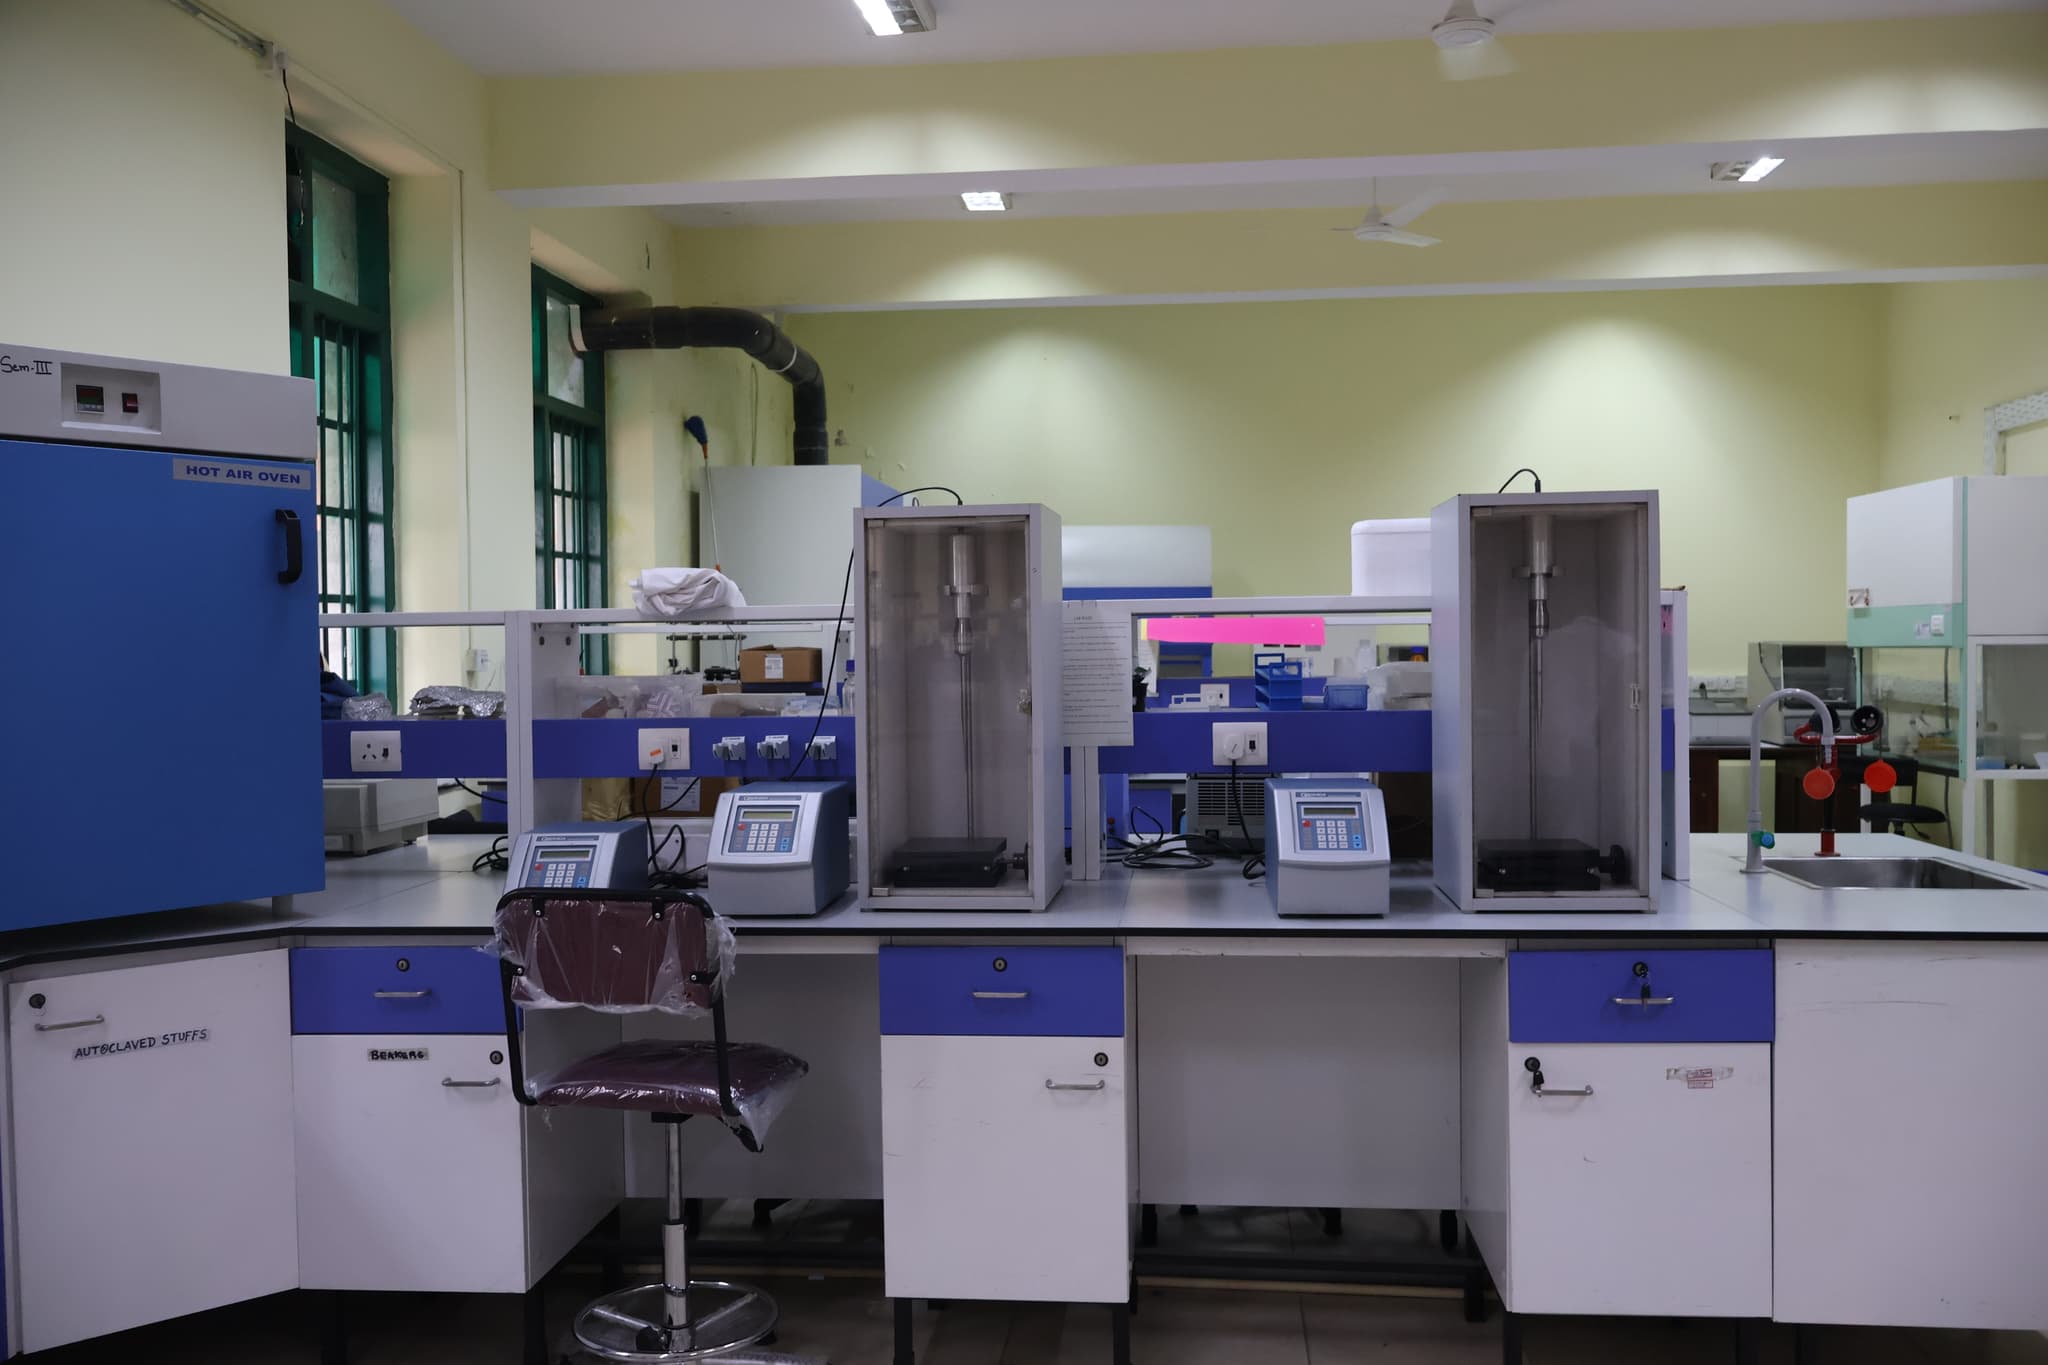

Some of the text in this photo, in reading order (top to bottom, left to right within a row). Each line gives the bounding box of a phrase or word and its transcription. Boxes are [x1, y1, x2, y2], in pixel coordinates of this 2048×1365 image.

[186, 465, 300, 484] HOT AIR OVEN
[74, 1029, 207, 1059] AUTOCLAVED STUFFS
